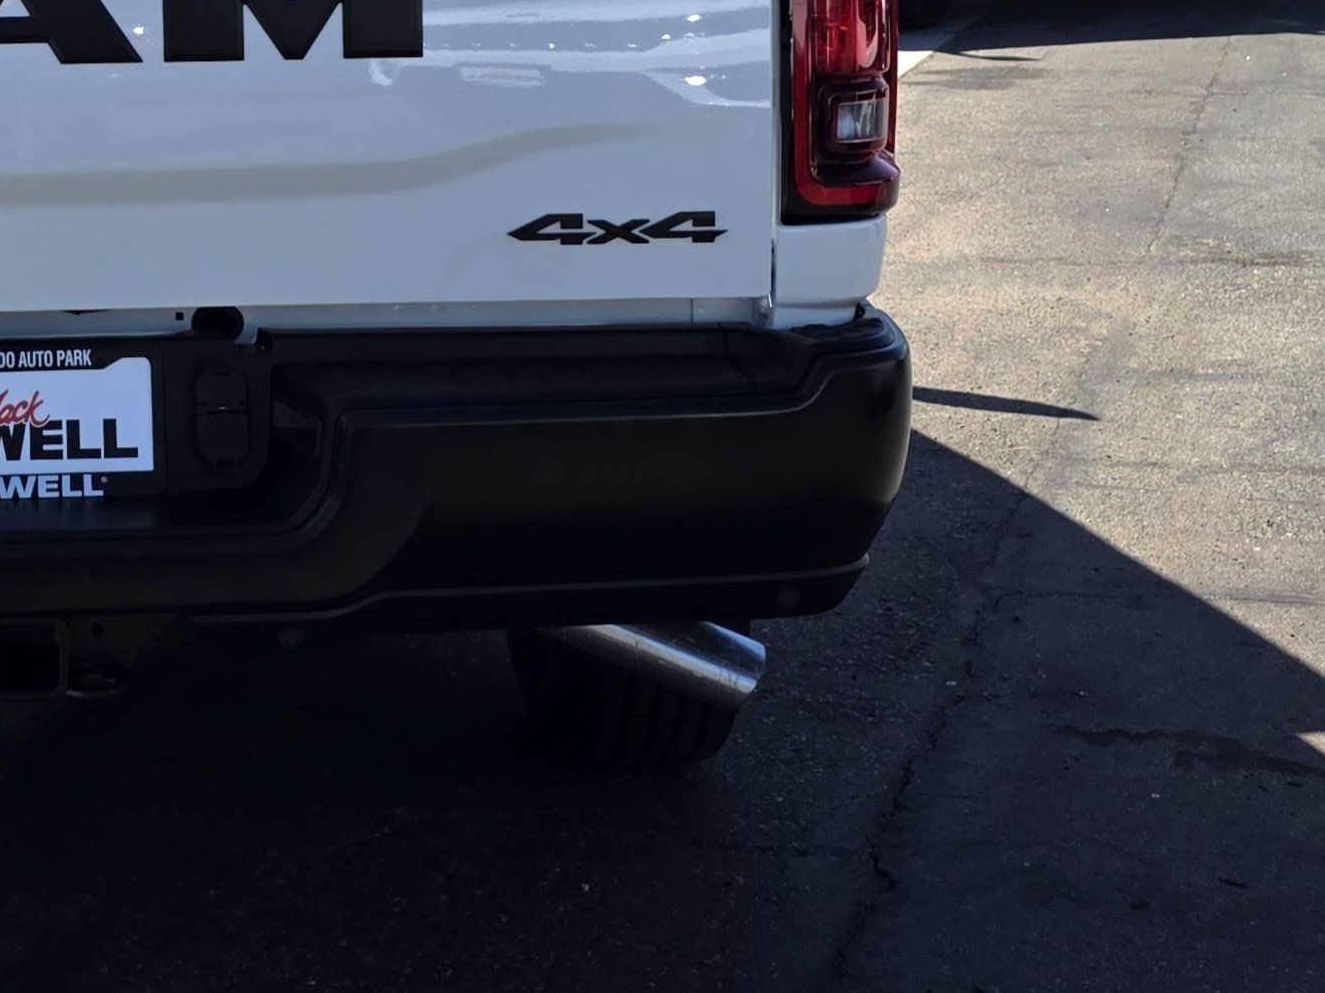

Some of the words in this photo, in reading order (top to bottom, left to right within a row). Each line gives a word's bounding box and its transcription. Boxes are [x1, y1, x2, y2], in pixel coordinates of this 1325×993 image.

[506, 210, 729, 246] 4x4
[18, 350, 53, 368] AUTO
[56, 349, 92, 367] PARK
